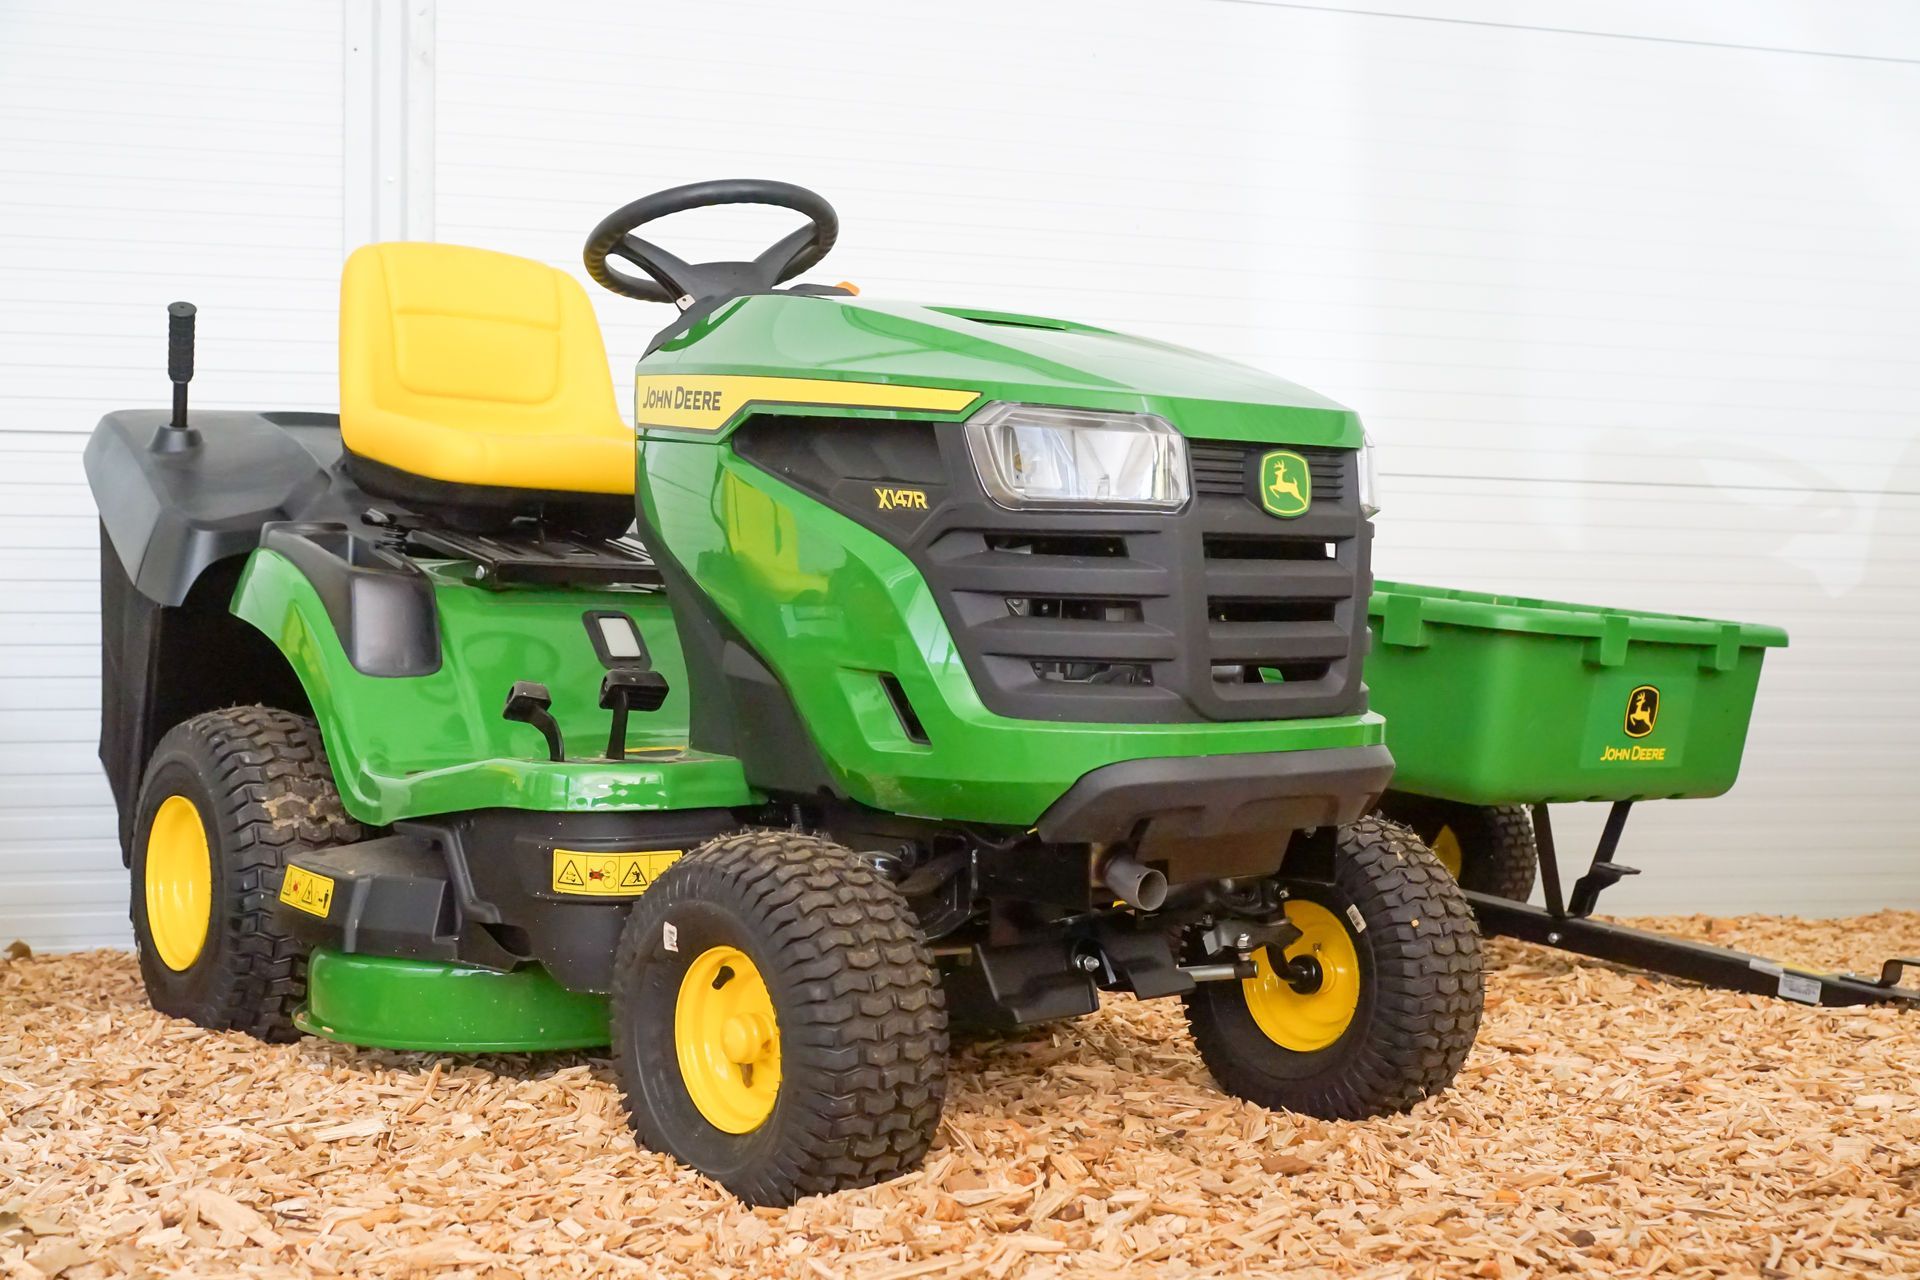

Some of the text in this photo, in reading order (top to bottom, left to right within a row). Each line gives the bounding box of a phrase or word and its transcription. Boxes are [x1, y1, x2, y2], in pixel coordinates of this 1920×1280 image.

[643, 386, 722, 411] JOHN DEERE
[874, 488, 928, 510] X147R
[1600, 745, 1666, 761] JOHN DEERE
